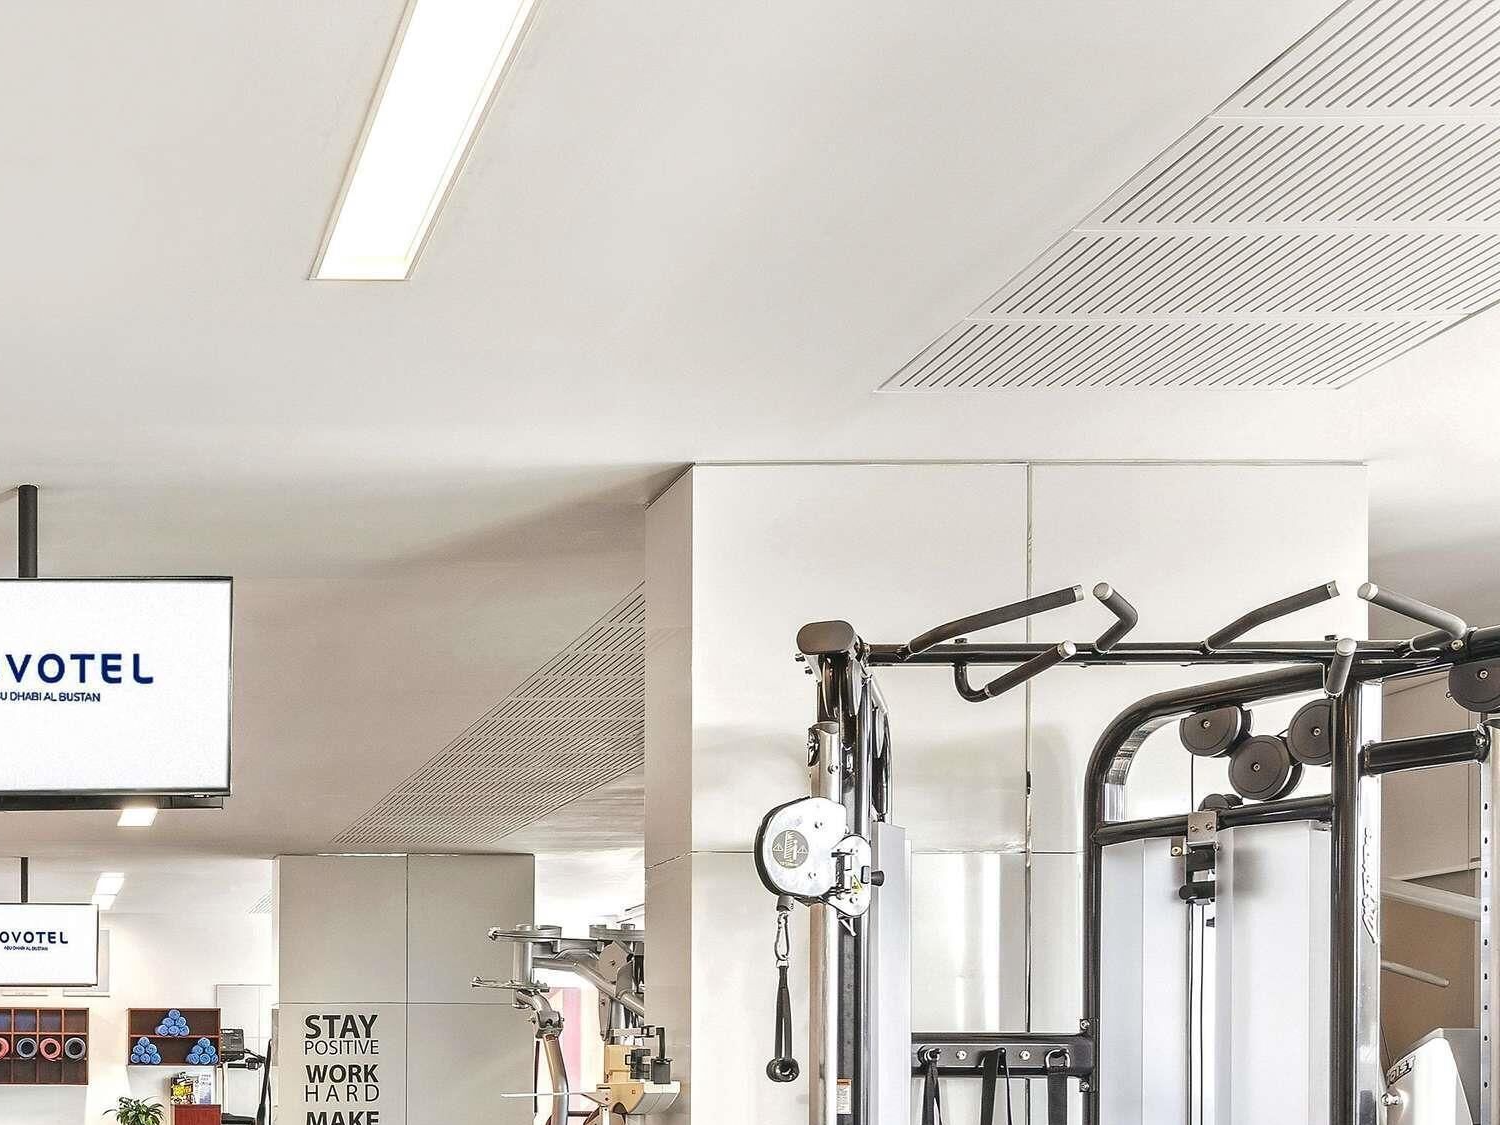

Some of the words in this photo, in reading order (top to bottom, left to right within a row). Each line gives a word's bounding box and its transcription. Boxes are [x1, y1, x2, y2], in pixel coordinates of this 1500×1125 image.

[10, 691, 42, 701] DHABI
[44, 692, 57, 702] AL
[58, 692, 101, 703] BUSTAN
[305, 1014, 378, 1039] STAY
[304, 1040, 379, 1055] POSITIVE
[305, 1064, 379, 1083] WORK
[305, 1084, 380, 1102] HARD
